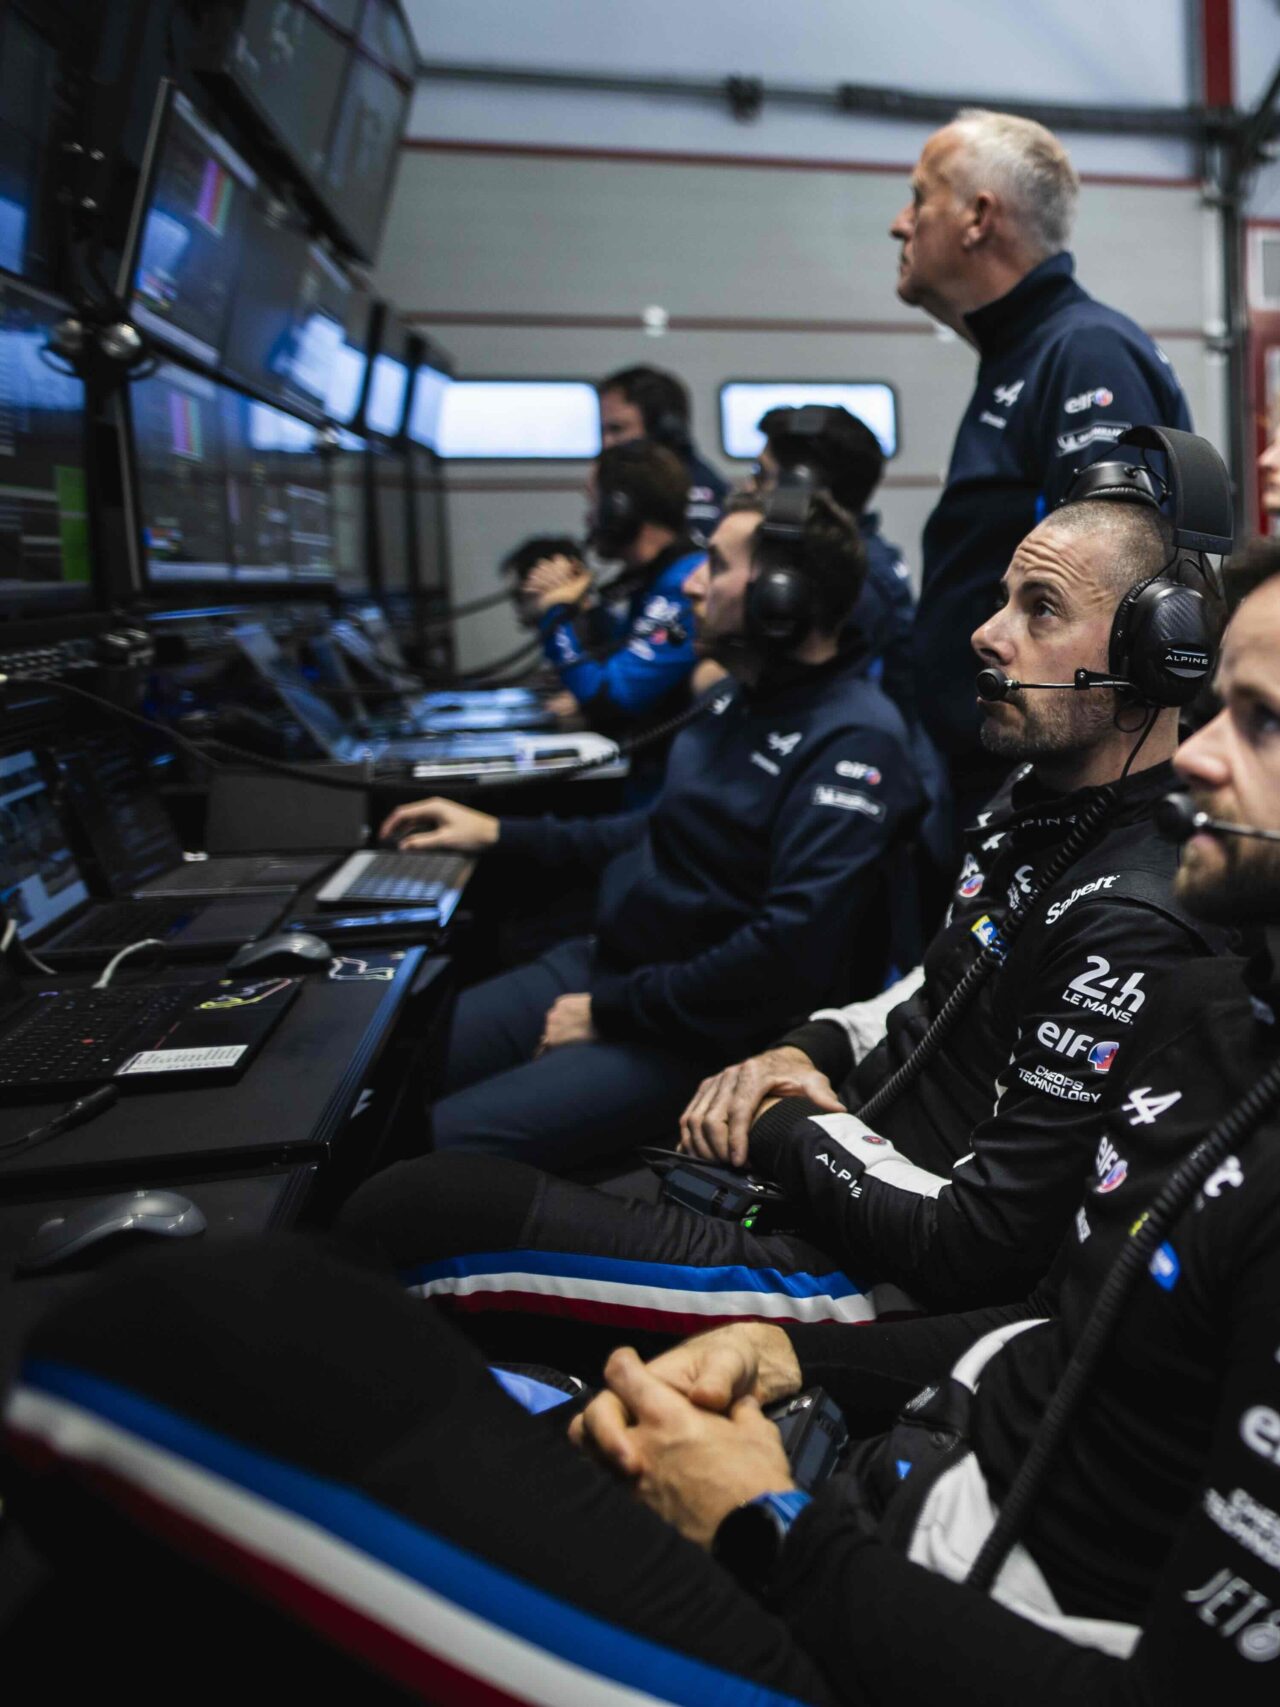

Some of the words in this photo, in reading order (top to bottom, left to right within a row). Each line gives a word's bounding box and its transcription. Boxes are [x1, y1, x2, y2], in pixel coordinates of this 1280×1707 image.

[1164, 654, 1208, 665] ALPINE
[1045, 874, 1120, 925] Sabelt
[1068, 955, 1146, 1013] 24h
[1061, 989, 1083, 1006] LE
[1082, 999, 1132, 1024] MANS
[1037, 1021, 1094, 1058] elf
[1018, 1067, 1101, 1103] TECHNOLOGY
[1034, 1065, 1084, 1091] CHEOPS
